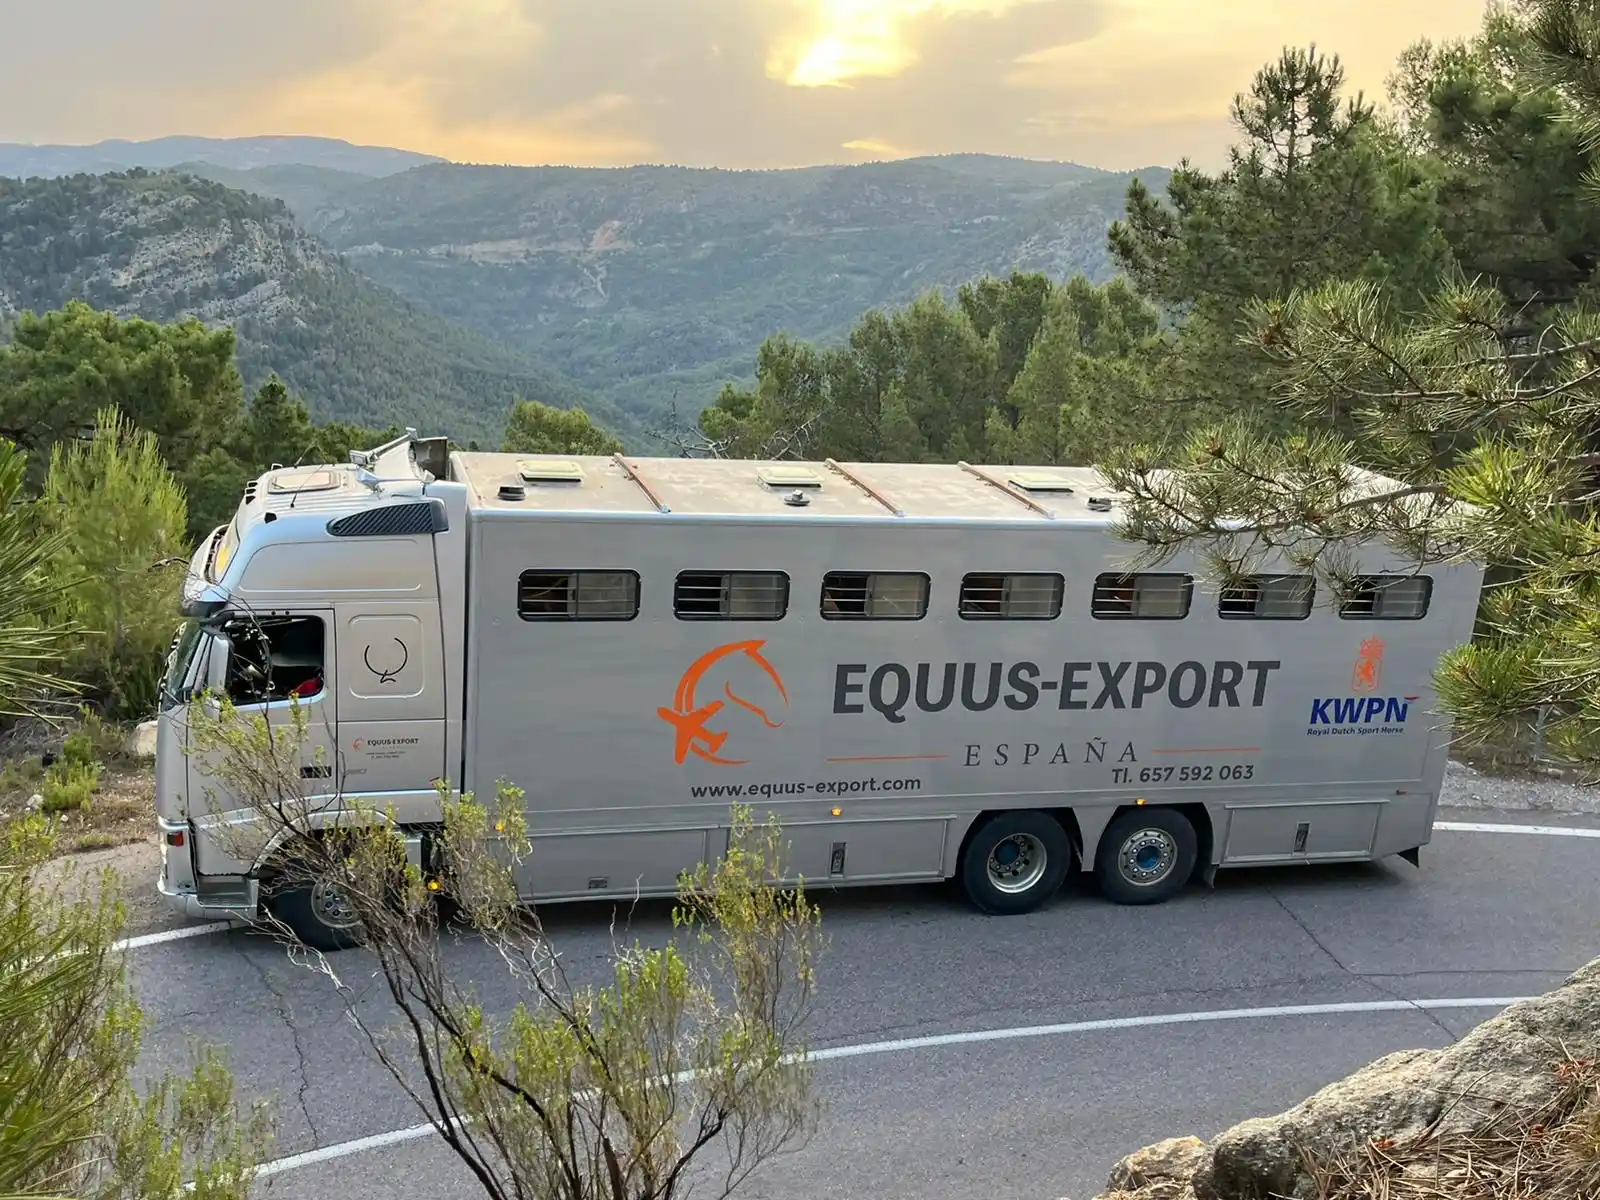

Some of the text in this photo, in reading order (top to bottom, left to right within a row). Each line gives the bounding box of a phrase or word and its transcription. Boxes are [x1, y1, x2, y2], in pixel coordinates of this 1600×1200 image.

[833, 661, 1281, 723] EQUUS-EXPORT
[1309, 697, 1408, 724] KWPN
[1307, 726, 1404, 737] Royal Dutch Sport Horse
[964, 737, 1138, 766] ESPAÑA
[1111, 764, 1254, 783] Tl. 657 592 063
[691, 776, 921, 798] www.equus-export.com
